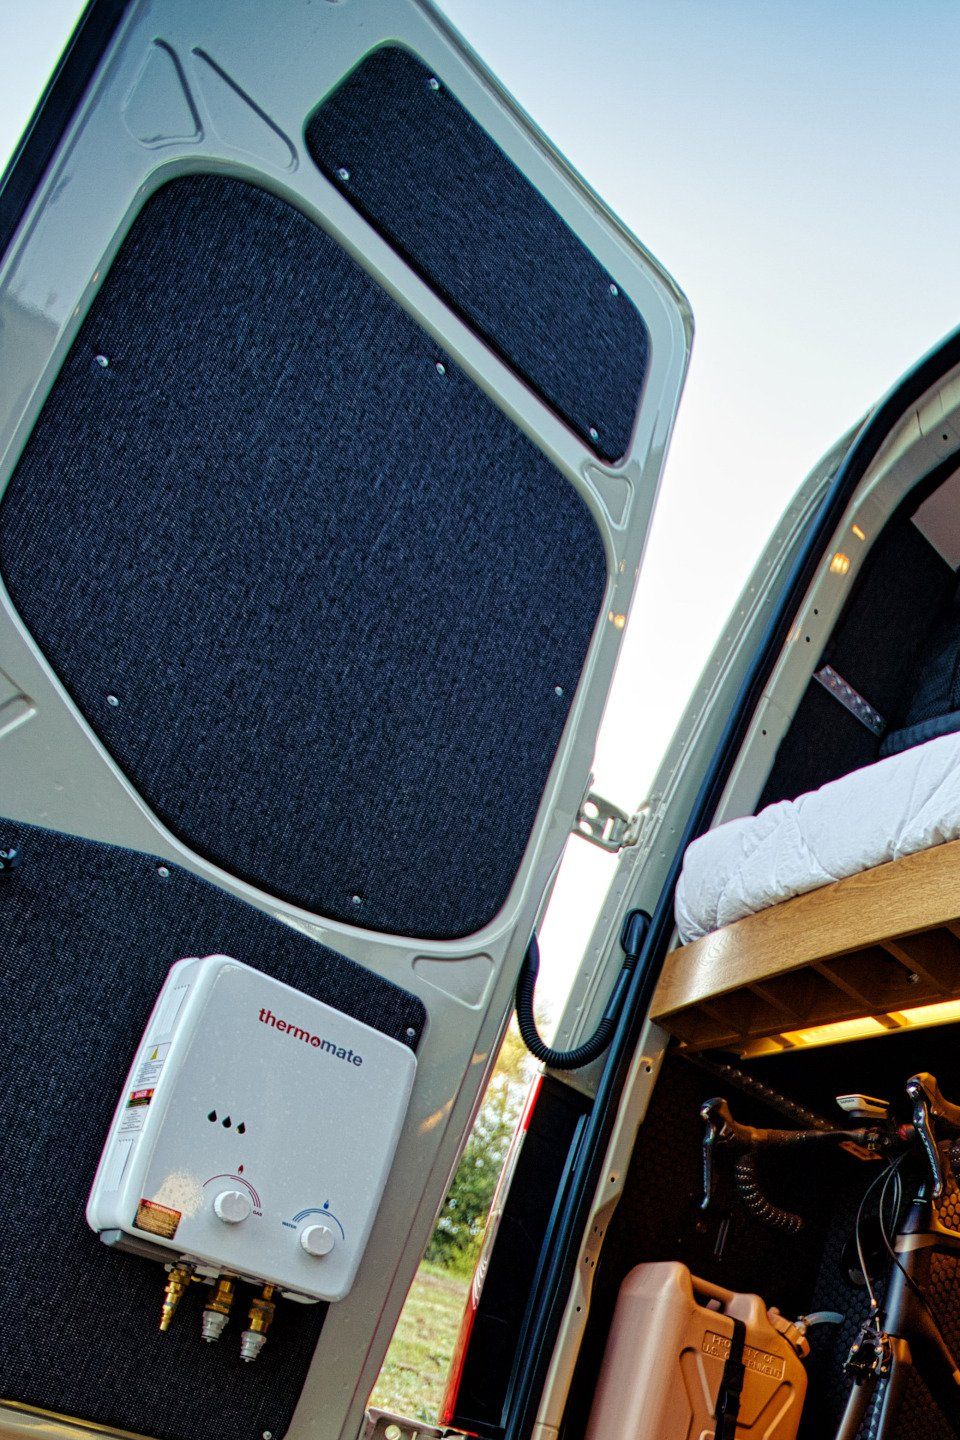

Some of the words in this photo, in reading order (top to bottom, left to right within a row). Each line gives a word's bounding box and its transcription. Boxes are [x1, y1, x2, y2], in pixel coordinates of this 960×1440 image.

[258, 1008, 363, 1067] thermomate
[712, 1334, 759, 1359] PROTY
[763, 1353, 776, 1364] OF
